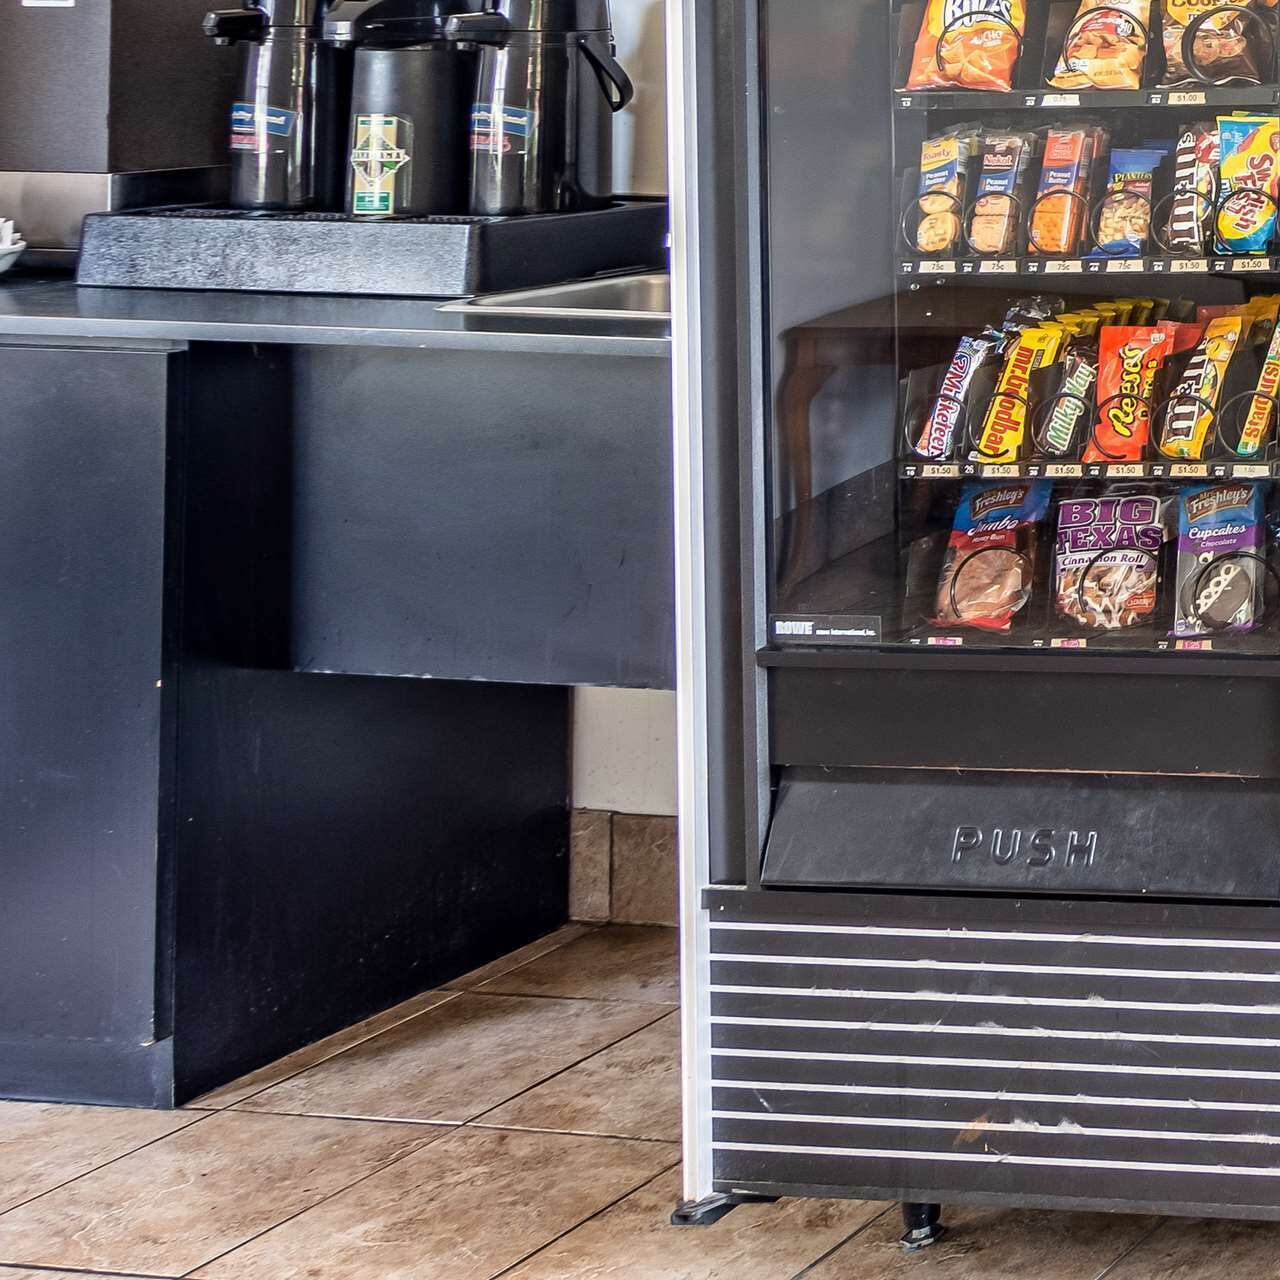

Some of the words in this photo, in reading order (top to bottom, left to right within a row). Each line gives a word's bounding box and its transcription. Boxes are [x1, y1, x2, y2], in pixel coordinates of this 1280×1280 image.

[1176, 94, 1198, 103] $1.00
[925, 170, 949, 179] Peanut
[1049, 171, 1071, 179] Peanut
[986, 178, 1008, 186] Peanut
[1179, 262, 1200, 270] $1.50
[1241, 260, 1262, 268] $1.50
[1244, 362, 1280, 438] Starurst
[930, 466, 951, 475] $1.50
[964, 464, 975, 474] 26
[991, 466, 1011, 474] $1.50
[1054, 466, 1076, 474] $1.50
[1115, 466, 1136, 474] $1.50
[1177, 466, 1199, 474] $1.50
[975, 489, 1024, 511] Freshley's
[1190, 487, 1249, 513] Freshley's
[1058, 495, 1160, 527] BIG
[967, 514, 1019, 536] Jumbo
[1188, 523, 1247, 540] Cupcakes
[1056, 525, 1164, 554] TEXAS
[1200, 537, 1237, 548] Chocolate
[1062, 554, 1117, 566] Cinnon
[1120, 554, 1144, 564] Roll
[775, 621, 815, 635] ROWE
[951, 825, 1098, 868] PUSH
